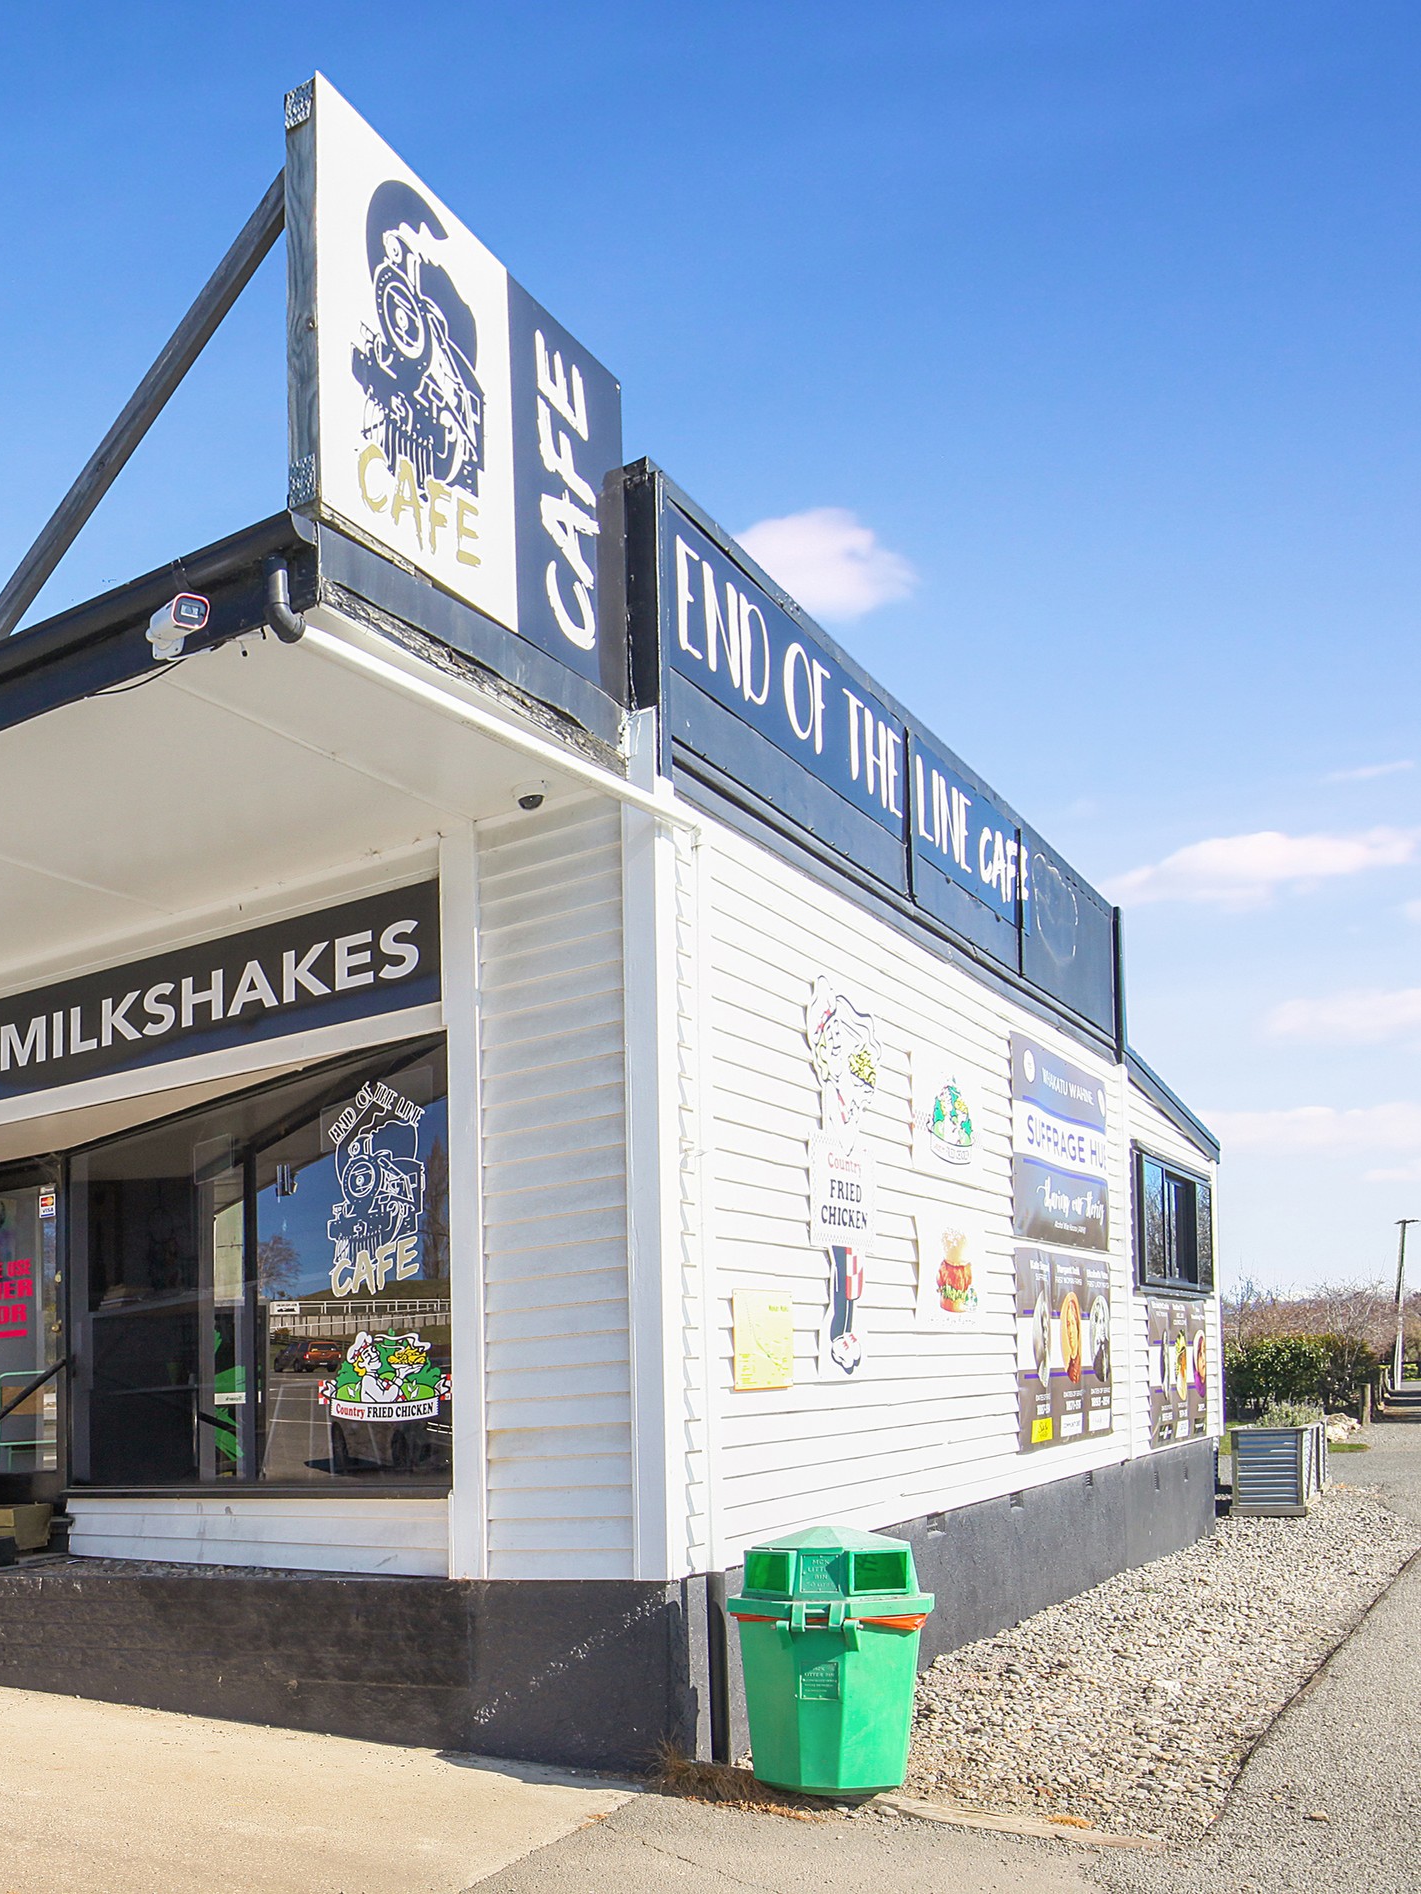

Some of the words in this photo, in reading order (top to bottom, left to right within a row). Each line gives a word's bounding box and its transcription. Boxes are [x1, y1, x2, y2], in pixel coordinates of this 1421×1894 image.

[358, 443, 481, 568] CAFE
[534, 329, 601, 650] CAFE
[676, 534, 770, 705] END
[783, 642, 831, 755] OF
[842, 687, 903, 818] THE
[915, 754, 972, 873] LINE
[979, 826, 1029, 903] CAFE
[0, 919, 420, 1071] MILKSHAKES
[328, 1107, 356, 1144] END
[355, 1081, 373, 1109] OF
[374, 1082, 398, 1110] THE
[395, 1097, 425, 1128] LINE
[1027, 1114, 1085, 1163] SUFFRAGE
[827, 1152, 861, 1178] Country
[830, 1179, 862, 1203] FRIED
[821, 1205, 868, 1229] CHICKEN
[7, 1258, 33, 1277] USE
[331, 1236, 419, 1297] CAFE
[336, 1403, 366, 1419] Country
[367, 1406, 394, 1418] FRIED
[395, 1401, 434, 1418] CHICKEN
